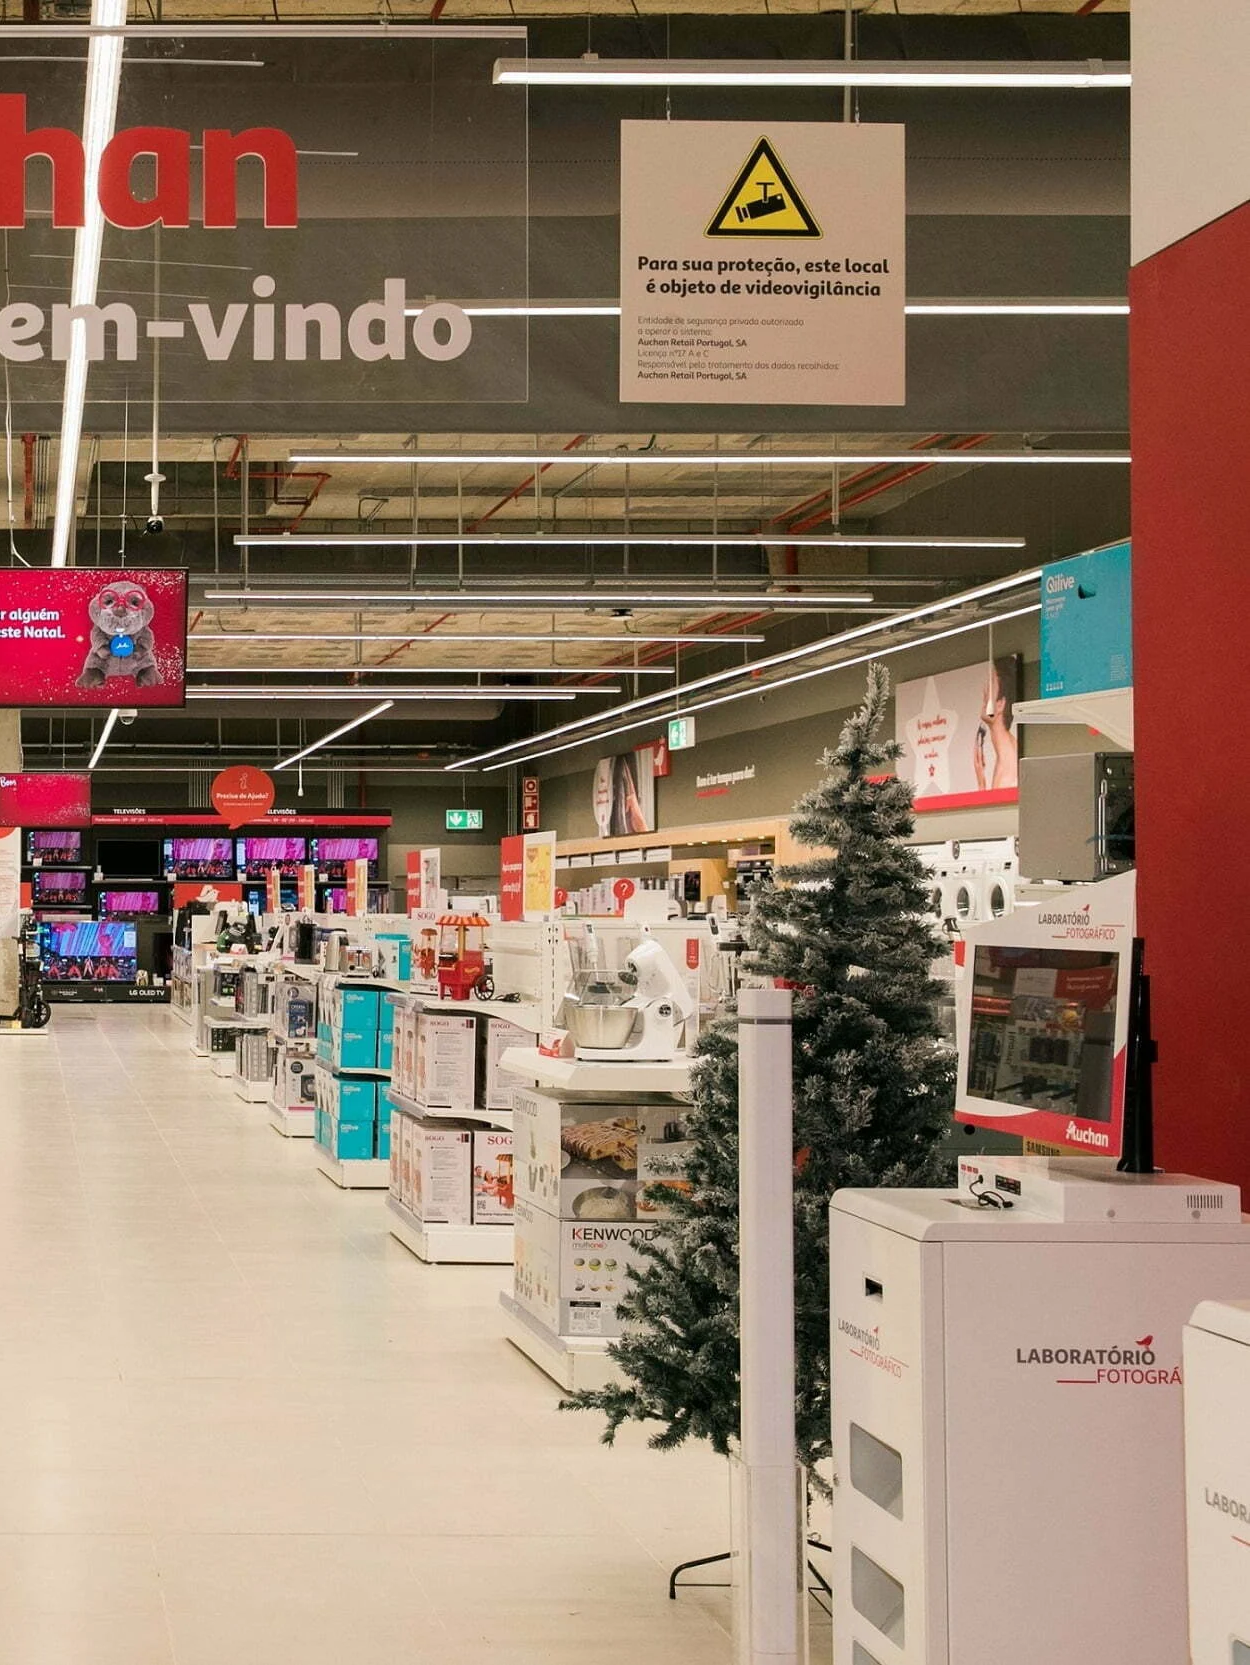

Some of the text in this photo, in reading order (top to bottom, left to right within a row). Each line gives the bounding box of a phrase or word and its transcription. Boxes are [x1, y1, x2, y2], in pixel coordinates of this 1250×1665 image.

[637, 256, 890, 277] Para sua proteção, este local
[646, 279, 881, 299] é objeto de videovigilância
[637, 338, 669, 346] Auchan
[670, 338, 695, 347] Retail
[735, 339, 747, 347] SA
[637, 371, 669, 379] Auchan
[670, 371, 695, 379] Retail
[735, 372, 747, 380] SA
[1046, 573, 1075, 594] Qilive
[9, 608, 60, 623] alguém
[23, 625, 66, 638] Natal.
[113, 807, 146, 815] TELEVISÕES
[417, 911, 436, 921] SOGO
[1037, 912, 1090, 926] LABORATÓRIO
[1066, 926, 1116, 941] FOTOGRÁFICO
[1065, 1120, 1109, 1148] Auchan
[838, 1317, 880, 1351] LABORATÓRIO
[861, 1345, 902, 1378] FOTOGRÁFICO
[1017, 1344, 1156, 1366] LABORATÓRIO
[1096, 1366, 1182, 1385] FOTOGRÁ
